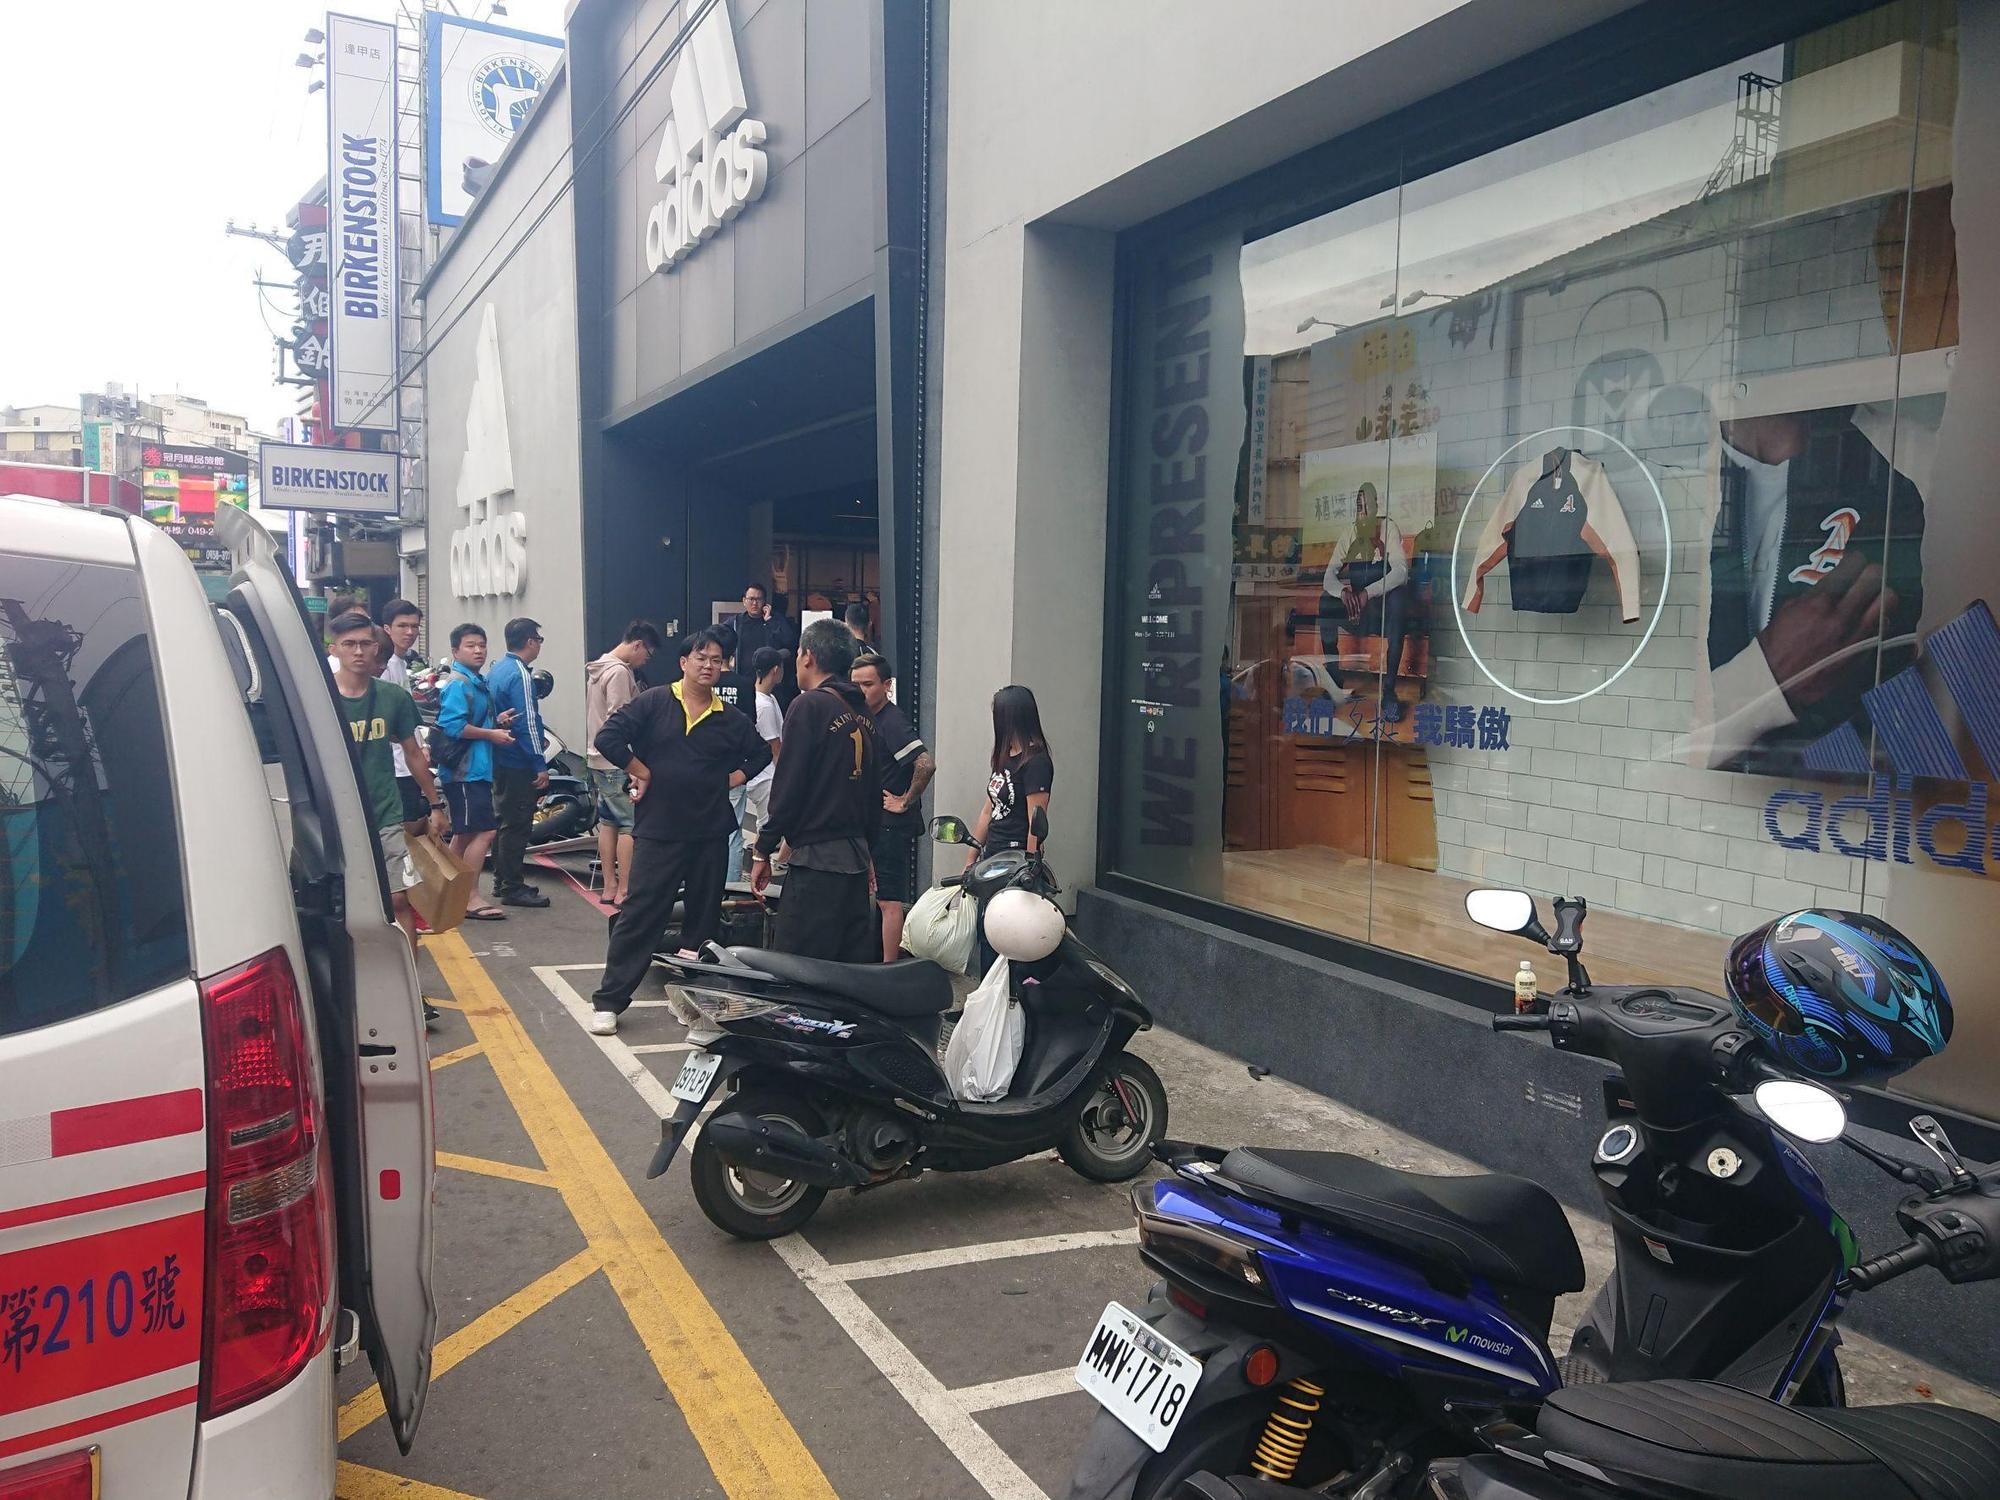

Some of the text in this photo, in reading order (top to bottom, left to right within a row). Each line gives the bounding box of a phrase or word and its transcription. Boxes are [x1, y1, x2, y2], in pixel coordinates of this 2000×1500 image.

[344, 43, 381, 60] 逢甲店
[475, 58, 547, 84] BIRKENSTO
[646, 118, 768, 273] adidas
[342, 132, 379, 320] BIRKENSTOCK
[272, 465, 389, 493] BIRKENSTOCK
[450, 497, 527, 600] adidas
[722, 686, 738, 696] FOR
[1764, 772, 2000, 875] adid
[1469, 1334, 1514, 1357] movistar
